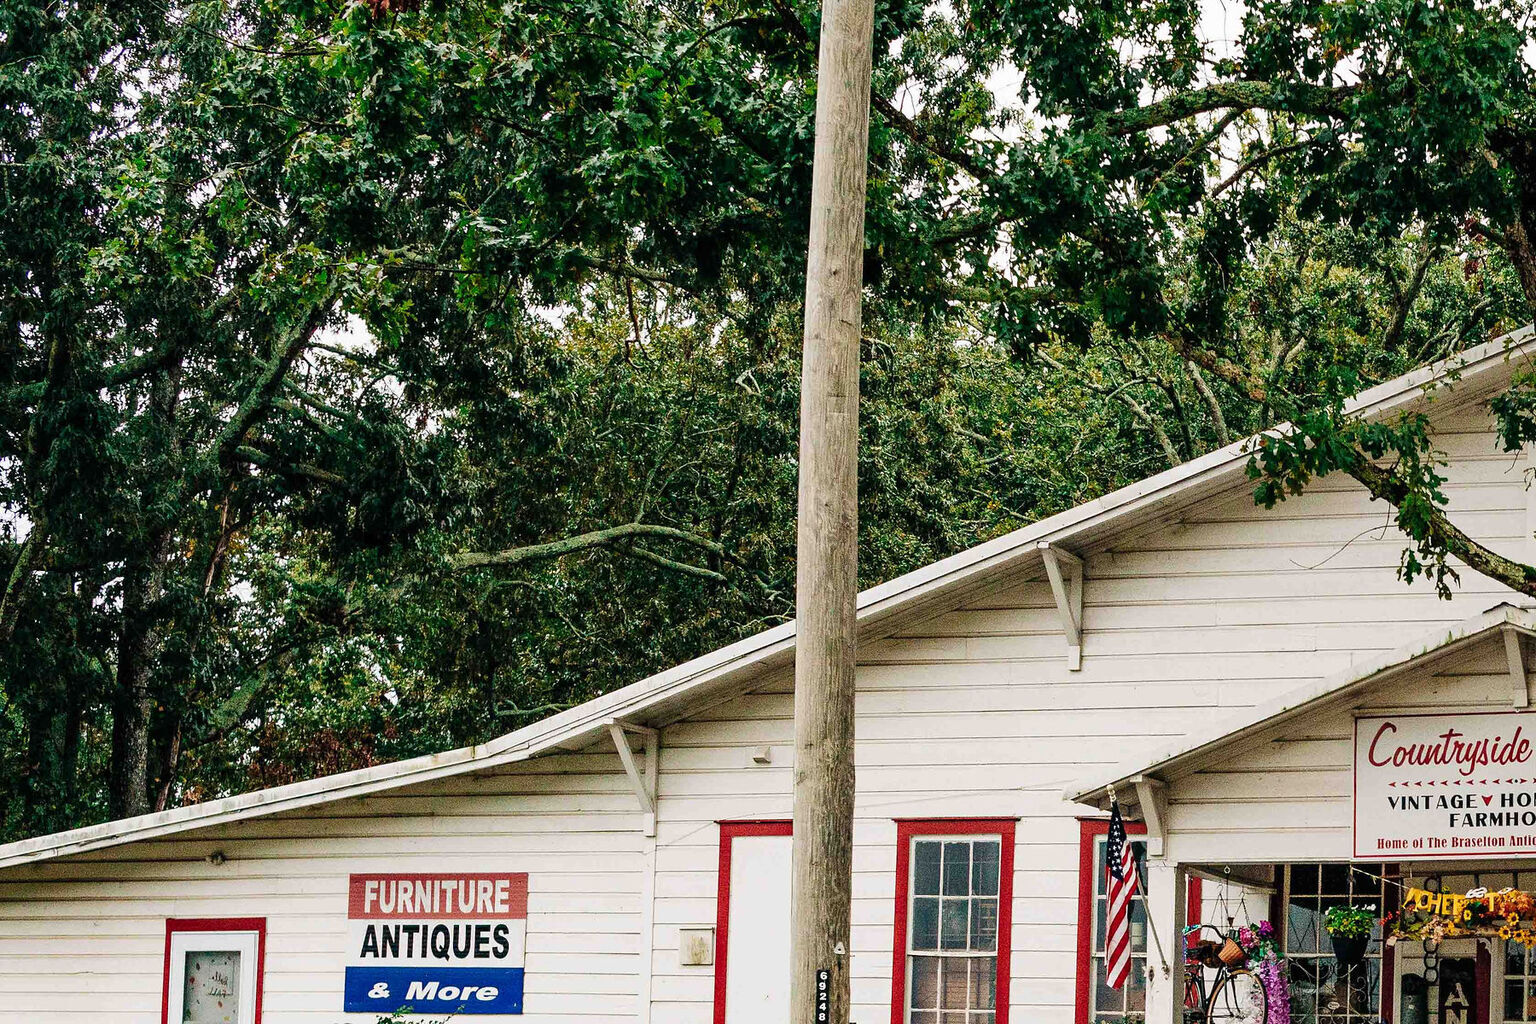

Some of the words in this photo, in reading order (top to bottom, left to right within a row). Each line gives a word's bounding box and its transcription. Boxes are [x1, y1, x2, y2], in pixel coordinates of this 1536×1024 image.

[1368, 722, 1533, 776] Countryside
[1387, 795, 1477, 811] VINTAGE
[1377, 838, 1409, 849] Home
[1412, 837, 1424, 848] of
[1427, 837, 1448, 848] The
[1451, 835, 1505, 848] Braselton
[364, 880, 510, 914] FURNITURE
[360, 924, 510, 961] ANTIQUES
[368, 982, 390, 998] &
[406, 981, 498, 1001] More
[818, 971, 828, 1021] 69248
